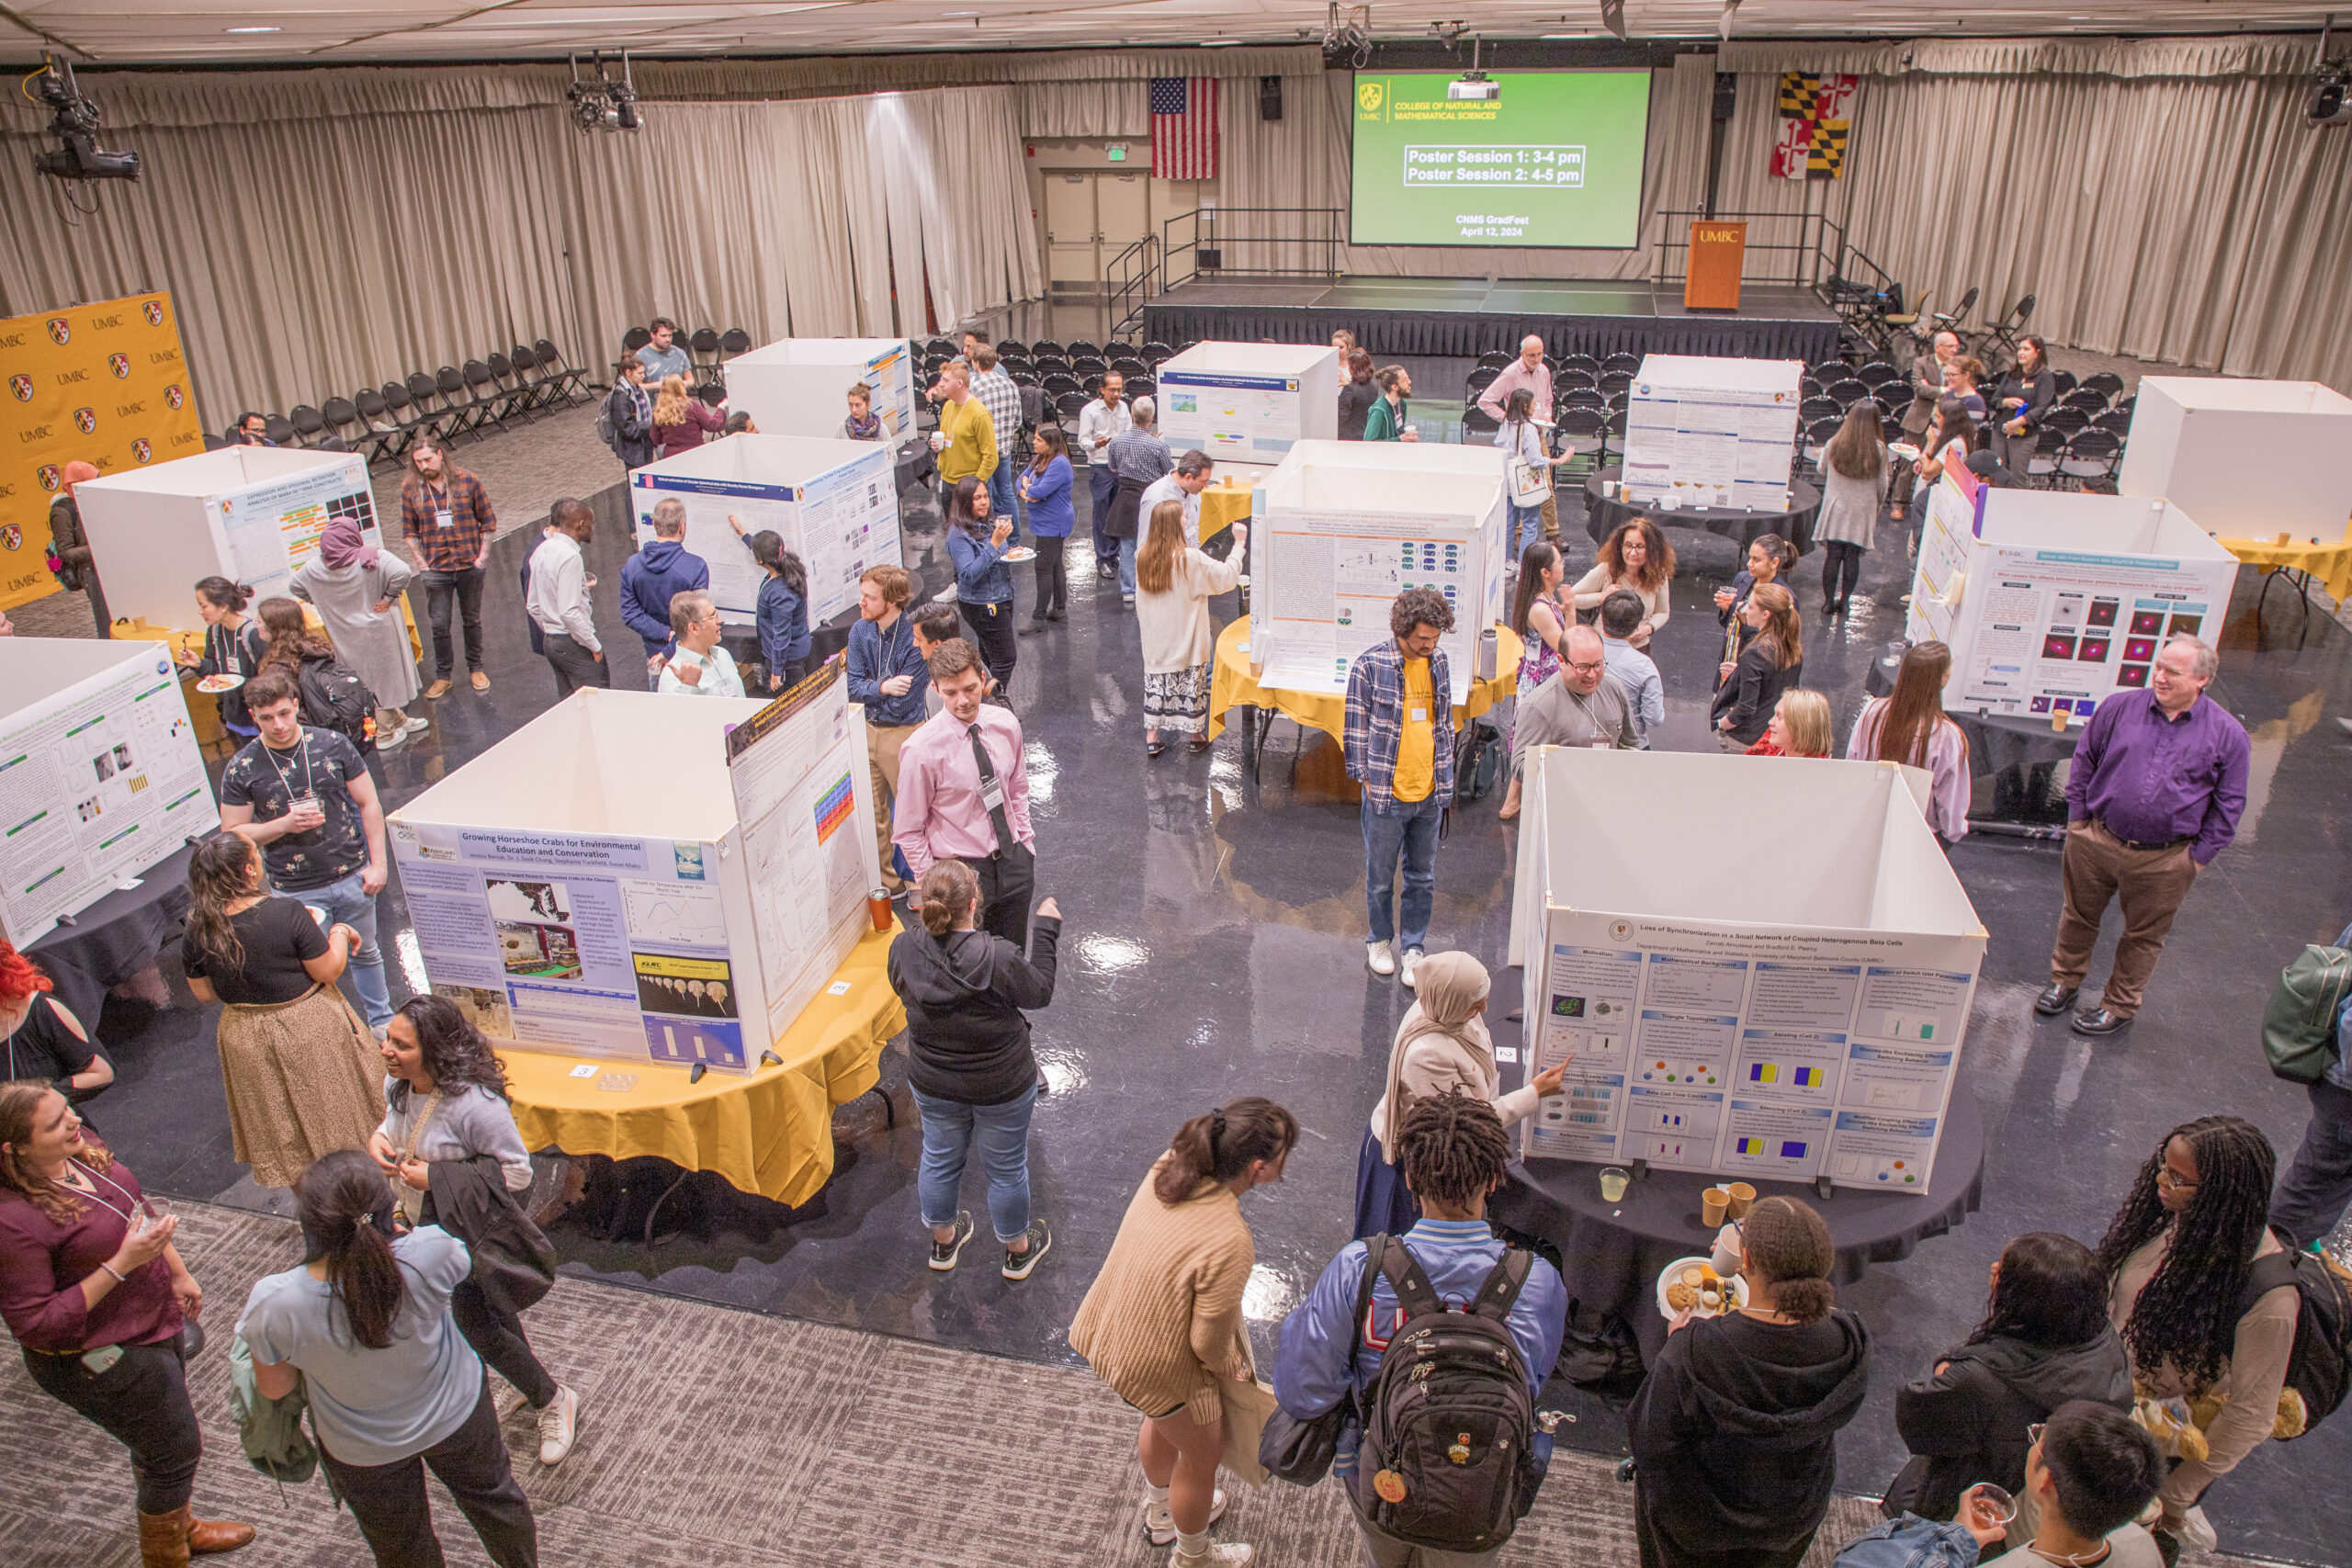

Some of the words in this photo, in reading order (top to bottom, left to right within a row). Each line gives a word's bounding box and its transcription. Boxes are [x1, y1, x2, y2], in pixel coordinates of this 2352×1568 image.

[1395, 102, 1430, 110] COLLEGE
[1432, 102, 1444, 110] OF
[1483, 101, 1502, 109] AND
[1395, 112, 1456, 120] MATHEMATICAL
[1408, 150, 1454, 164] Poster
[1456, 150, 1512, 164] Session
[1516, 151, 1529, 164] 1:
[1532, 151, 1555, 164] 3-4
[1557, 153, 1581, 166] pm
[1408, 167, 1453, 181] Poster
[1456, 167, 1511, 181] Session
[1514, 168, 1528, 181] 2:
[1531, 168, 1554, 181] 4-5
[1556, 171, 1579, 184] pm
[1455, 215, 1485, 224] CNMS
[1487, 215, 1529, 225] GradFest
[1461, 228, 1483, 237] April
[1486, 228, 1498, 237] 12,
[1500, 228, 1522, 237] 2024
[1700, 230, 1739, 243] UMBC
[92, 314, 124, 331] UMBC
[0, 333, 27, 349] MBC
[150, 348, 179, 365] UMBC
[56, 368, 90, 386] UMBC
[117, 400, 147, 418] UMBC
[19, 425, 53, 443] UMBC
[170, 430, 198, 447] UMBC
[86, 456, 114, 469] MBC
[0, 483, 17, 499] BC
[7, 571, 41, 592] UMBC
[462, 832, 496, 843] Growing
[497, 835, 540, 845] Horseshoe
[542, 838, 565, 847] Crabs
[566, 839, 579, 847] for
[580, 840, 641, 851] Environmental
[719, 840, 728, 853] 3A
[496, 845, 537, 854] Education
[537, 848, 553, 856] and
[555, 849, 610, 858] Conservation
[1666, 927, 1720, 938] Synchronization
[1792, 935, 1820, 943] Coupled
[1821, 937, 1868, 945] Heterogenous
[1582, 949, 1613, 957] Motivation
[1636, 942, 1668, 952] Department
[1676, 946, 1711, 954] Mathematics
[1751, 953, 1779, 961] University
[1660, 956, 1700, 965] Mathematical
[1762, 964, 1810, 972] Synchronization
[1935, 973, 1967, 981] Parameters
[1685, 1015, 1717, 1023] Topologies
[578, 1067, 589, 1076] 3
[1759, 1104, 1786, 1113] Silencing
[1559, 1132, 1590, 1140] References
[1449, 1444, 1470, 1456] UMBC
